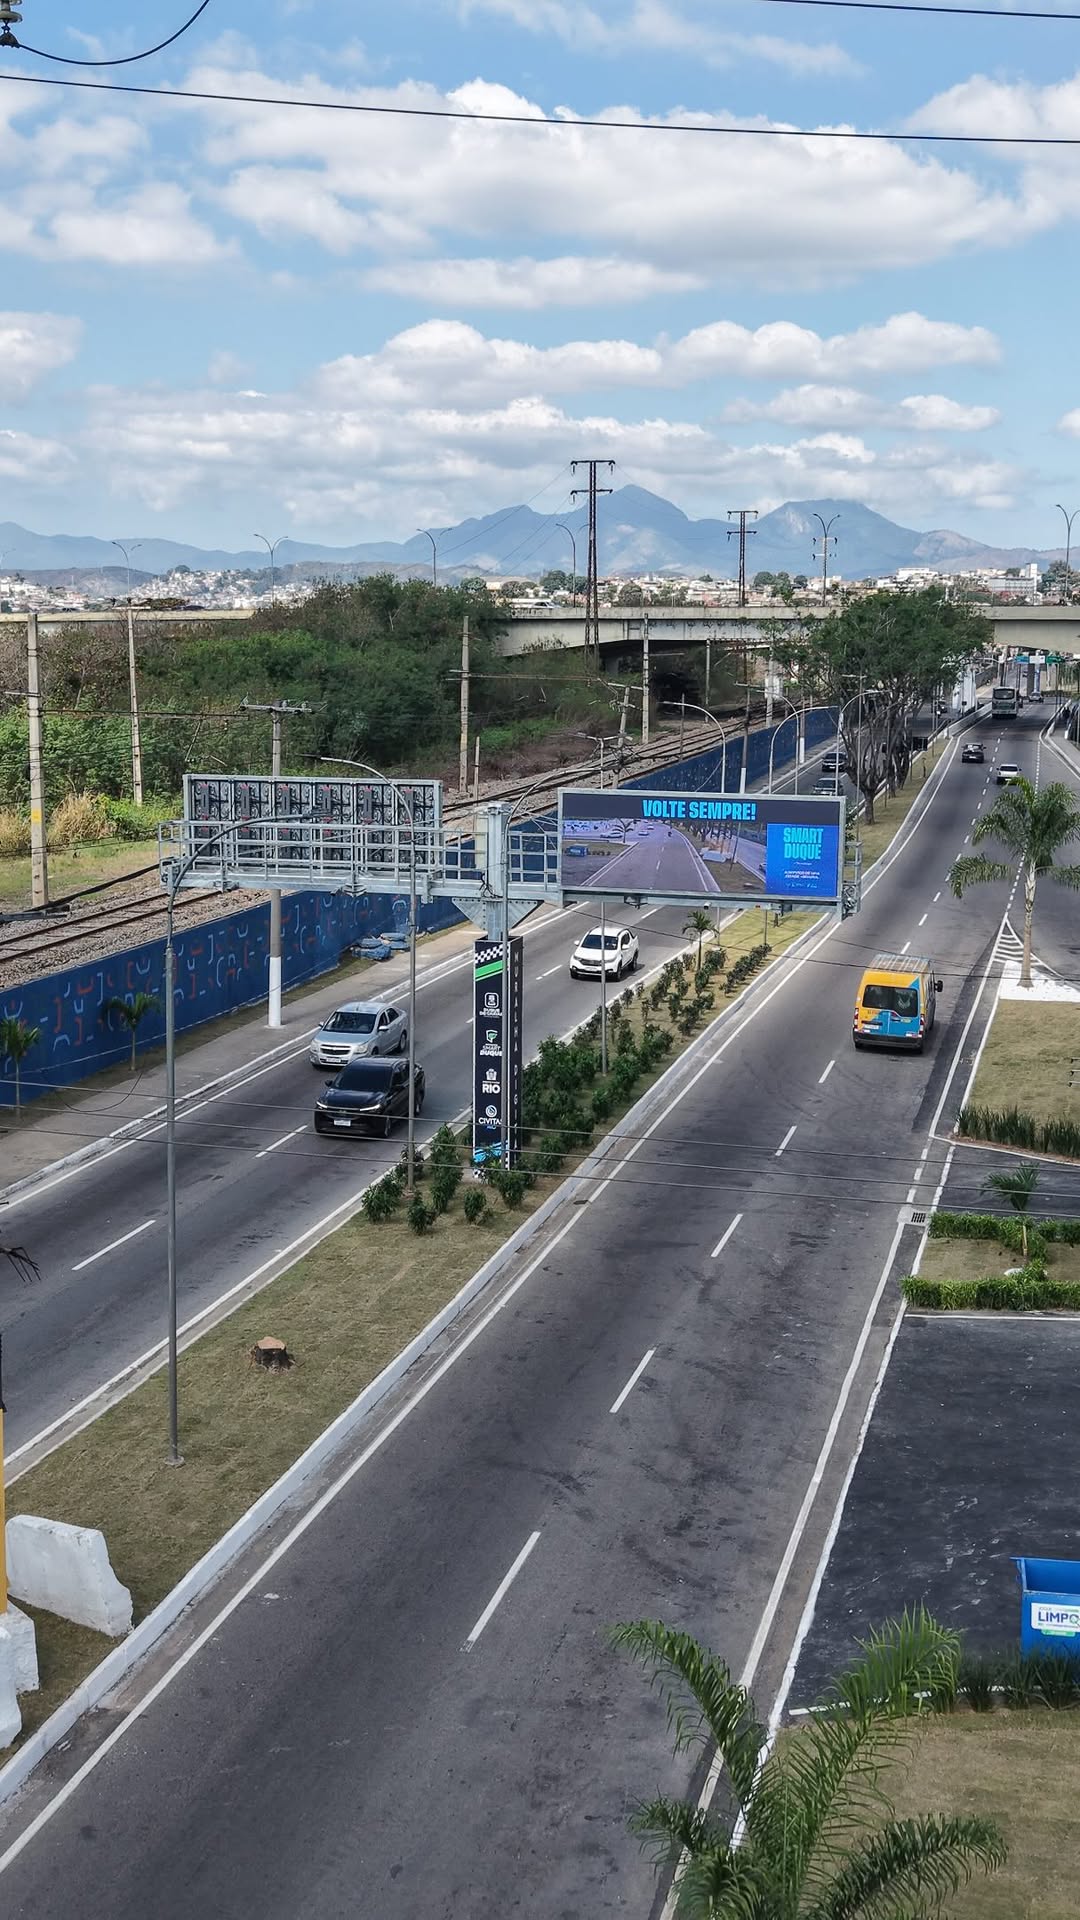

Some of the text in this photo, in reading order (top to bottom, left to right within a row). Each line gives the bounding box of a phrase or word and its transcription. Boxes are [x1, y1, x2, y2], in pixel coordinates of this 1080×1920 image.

[642, 799, 757, 821] VOLTE SEMPRE!
[783, 827, 824, 844] SMART
[783, 843, 822, 861] DUQUE
[482, 1084, 501, 1094] RIO
